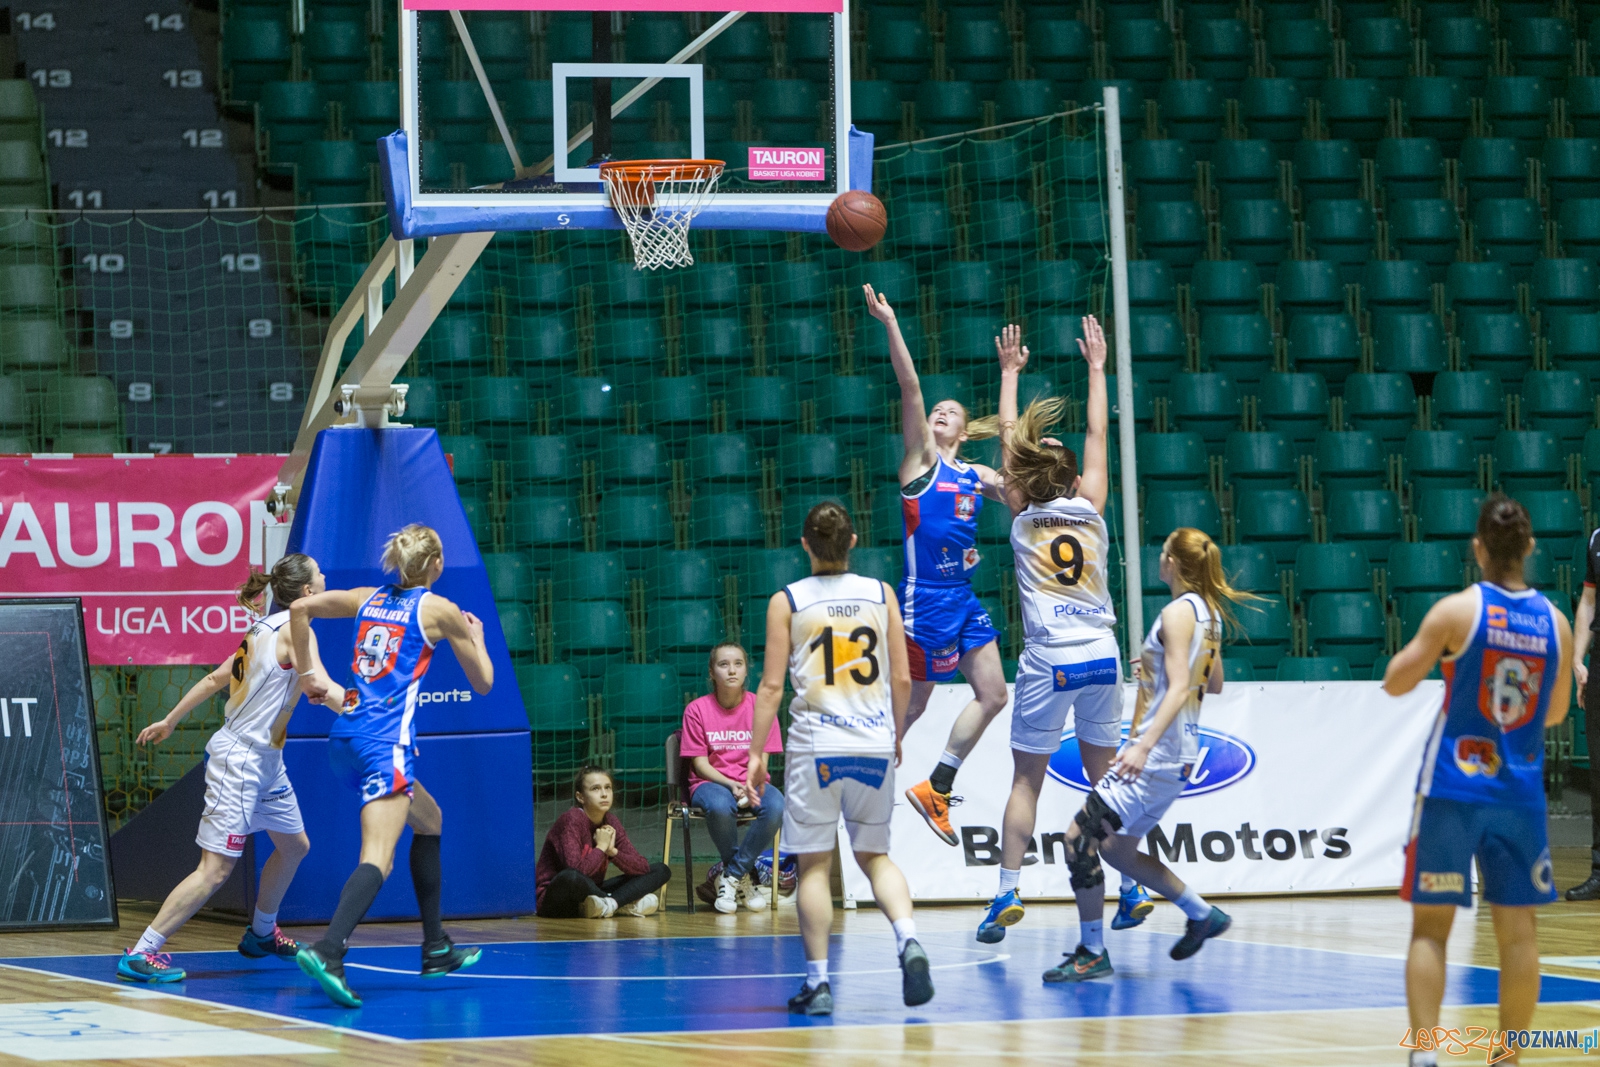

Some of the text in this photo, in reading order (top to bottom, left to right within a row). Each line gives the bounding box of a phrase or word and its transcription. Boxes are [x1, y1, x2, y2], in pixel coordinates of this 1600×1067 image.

[16, 13, 55, 30] 14
[145, 13, 184, 31] 14
[32, 69, 71, 87] 13
[163, 69, 202, 87] 13
[48, 130, 89, 147] 12
[183, 130, 223, 147] 12
[753, 150, 820, 165] TAURON
[68, 190, 103, 208] 11
[203, 190, 237, 207] 11
[83, 254, 124, 272] 10
[220, 254, 261, 272] 10
[110, 320, 133, 338] 9
[249, 319, 272, 337] 9
[129, 382, 151, 401] 8
[270, 382, 293, 401] 8
[1050, 534, 1084, 586] 9
[96, 606, 170, 634] LIGA
[827, 605, 860, 617] DROP
[358, 624, 391, 677] 9
[810, 626, 879, 686] 13
[415, 689, 471, 707] ports
[1492, 657, 1530, 726] 6
[1146, 822, 1352, 863] Motors
